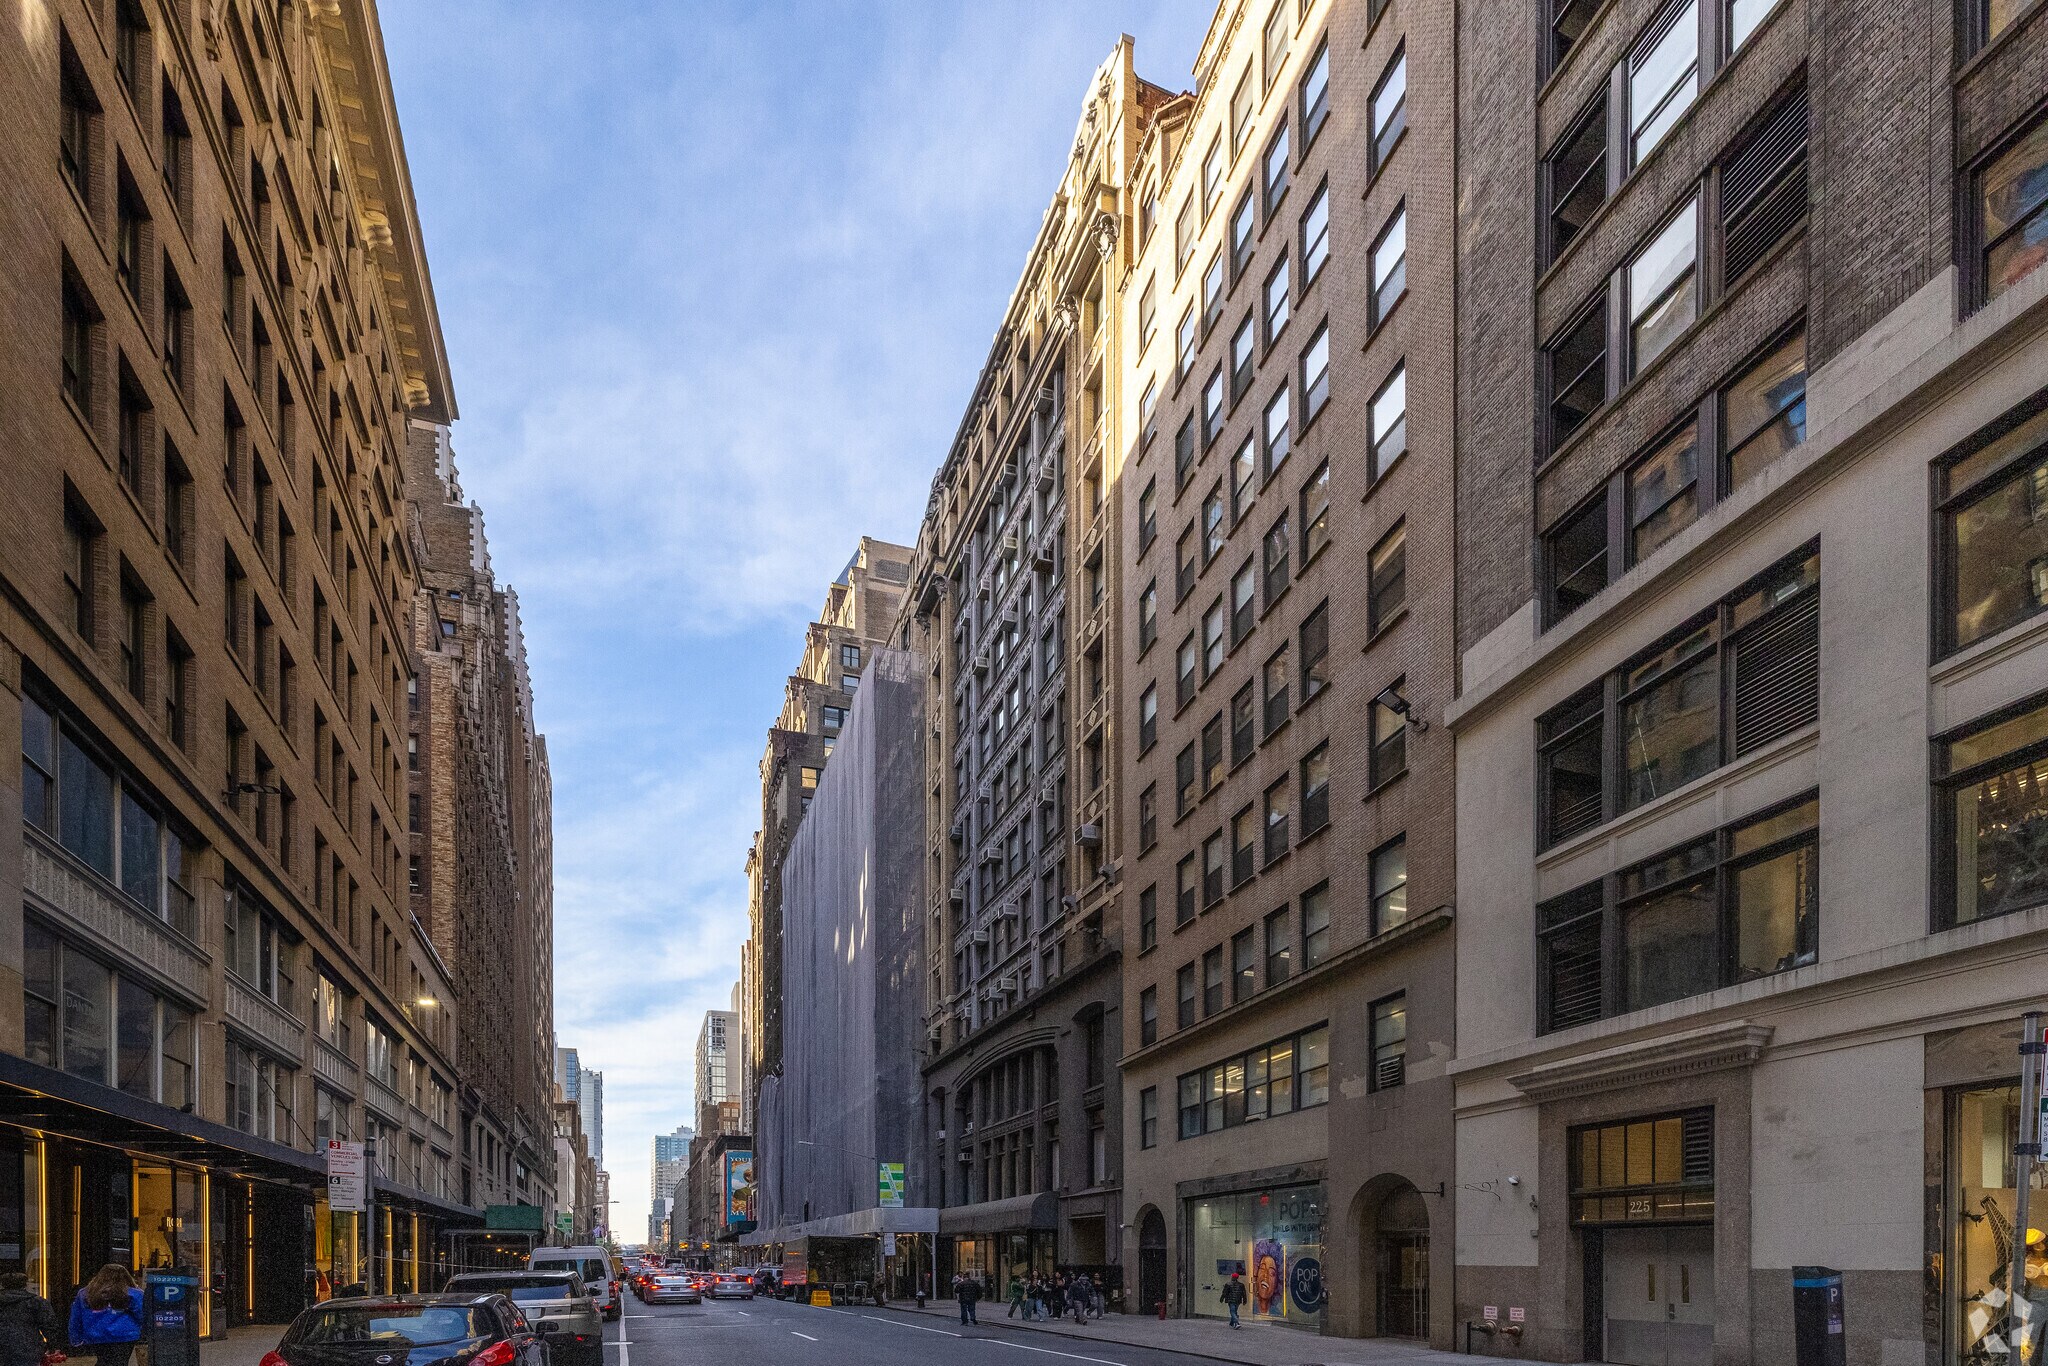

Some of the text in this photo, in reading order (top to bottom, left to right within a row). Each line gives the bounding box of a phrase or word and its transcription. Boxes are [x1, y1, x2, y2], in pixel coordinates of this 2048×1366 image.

[331, 1141, 339, 1149] 3
[1280, 1201, 1310, 1220] POP
[1630, 1200, 1650, 1213] 225
[1297, 1268, 1318, 1281] POP
[164, 1286, 179, 1300] P
[1299, 1280, 1311, 1293] ON
[1830, 1288, 1838, 1302] P
